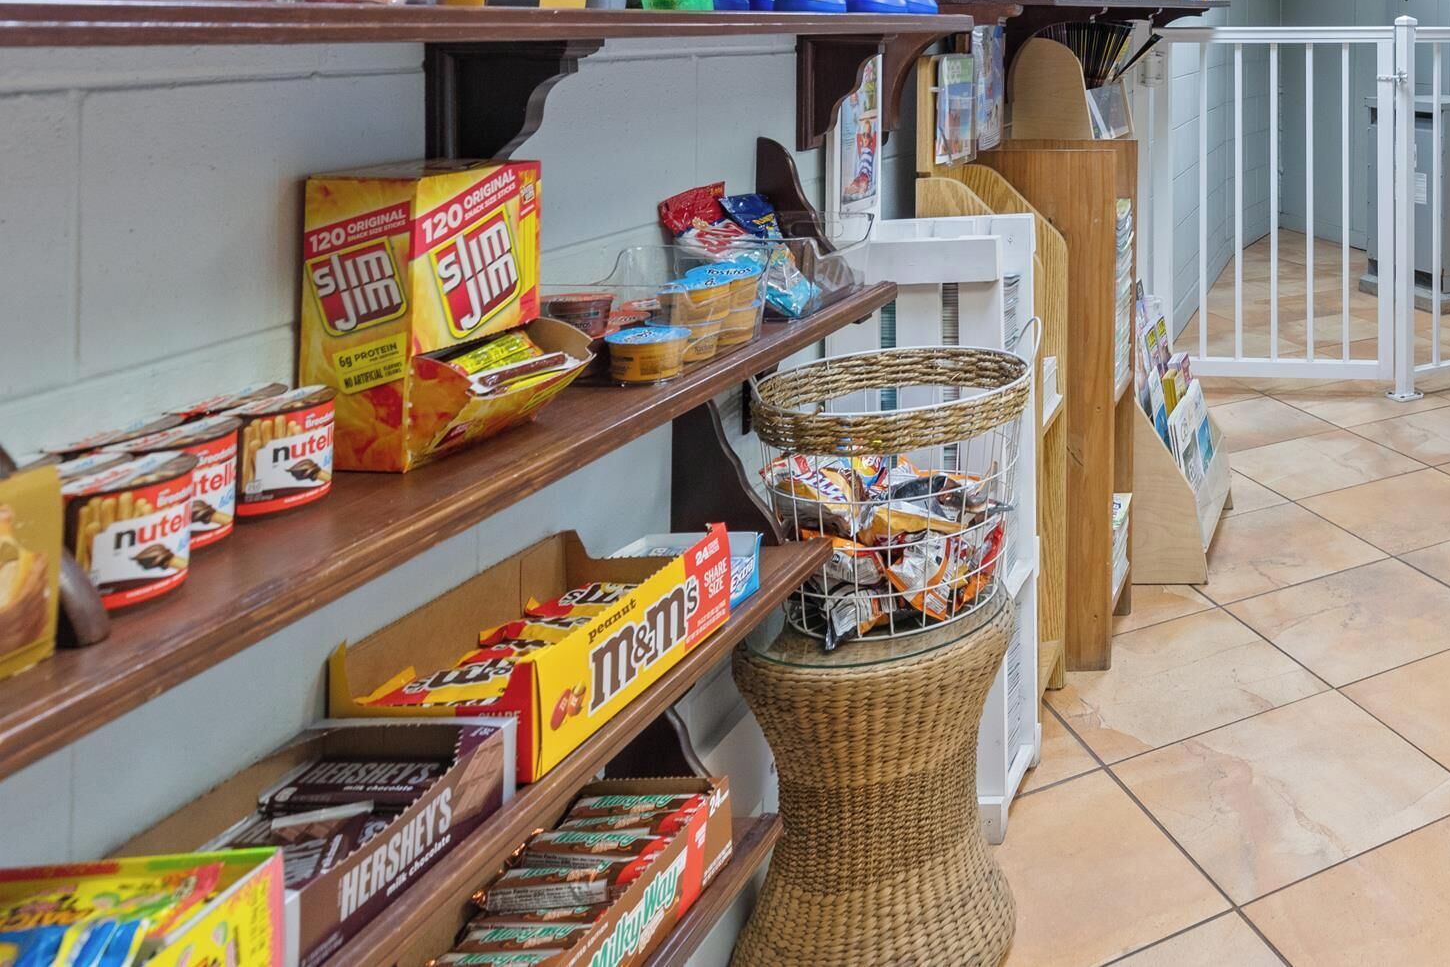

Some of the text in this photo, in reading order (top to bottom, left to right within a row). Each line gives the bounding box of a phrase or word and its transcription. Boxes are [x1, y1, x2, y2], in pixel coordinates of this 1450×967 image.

[420, 168, 517, 244] 120 ORIGINAL
[484, 195, 498, 209] SIZE
[309, 208, 407, 253] 120 ORIGINAL
[338, 355, 353, 368] 6g
[354, 342, 398, 362] PROTEIN
[695, 545, 709, 567] 24
[703, 556, 729, 587] SHARE
[708, 575, 725, 599] SIZE
[588, 597, 637, 644] peanut
[587, 575, 700, 718] m&m's
[301, 762, 440, 785] HERSHEY'S
[340, 786, 452, 923] HERSHEY'S
[408, 833, 452, 877] chocolate
[641, 864, 680, 929] Way
